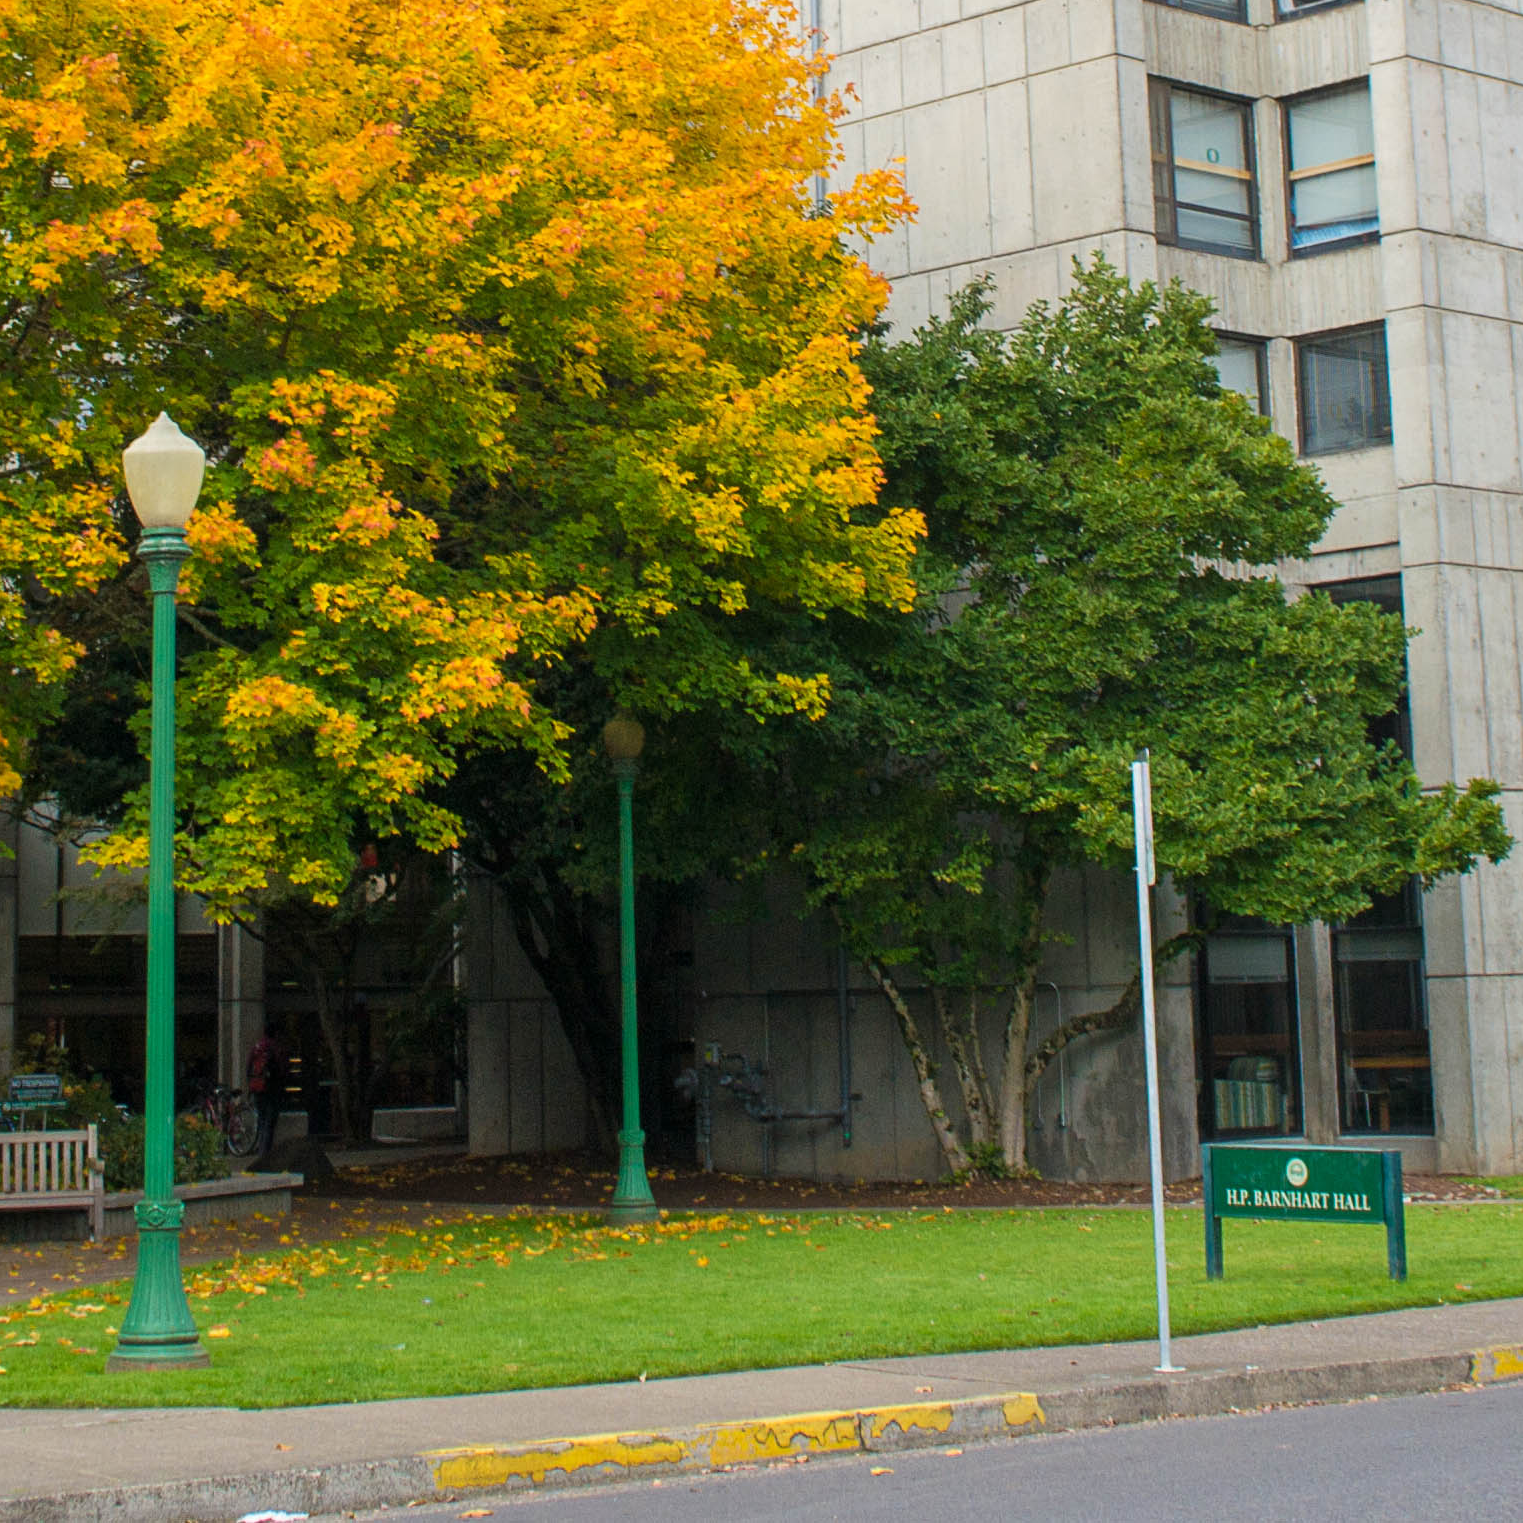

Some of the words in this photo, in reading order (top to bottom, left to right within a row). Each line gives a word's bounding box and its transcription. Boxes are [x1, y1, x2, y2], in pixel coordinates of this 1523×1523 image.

[1226, 1188, 1251, 1206] H.P.
[1253, 1189, 1330, 1209] BARNHART
[1333, 1192, 1371, 1211] HALL
